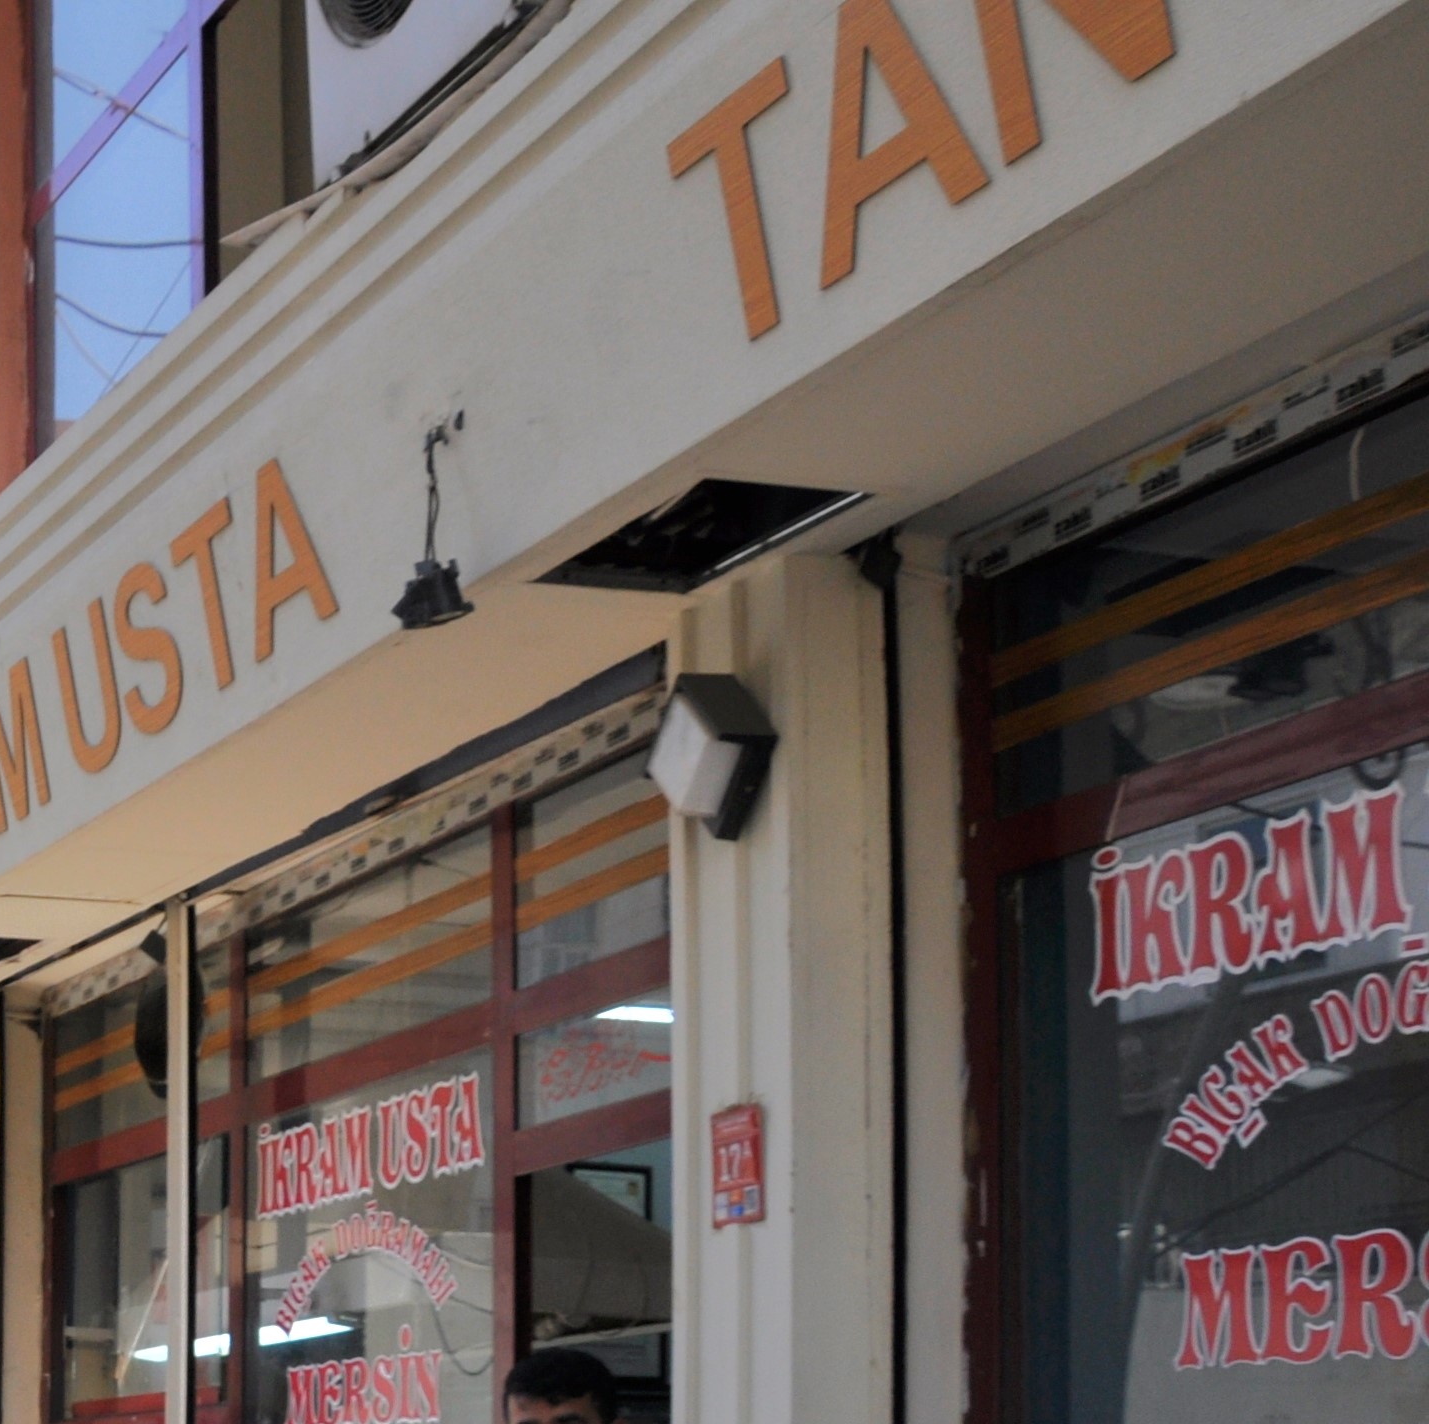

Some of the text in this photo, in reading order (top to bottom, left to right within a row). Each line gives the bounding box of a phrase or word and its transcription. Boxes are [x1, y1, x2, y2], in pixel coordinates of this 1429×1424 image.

[50, 457, 340, 774] USTA
[1090, 783, 1413, 1005] İKRAM
[257, 1071, 485, 1219] İKRAM USTA
[1175, 1228, 1429, 1371] MER
